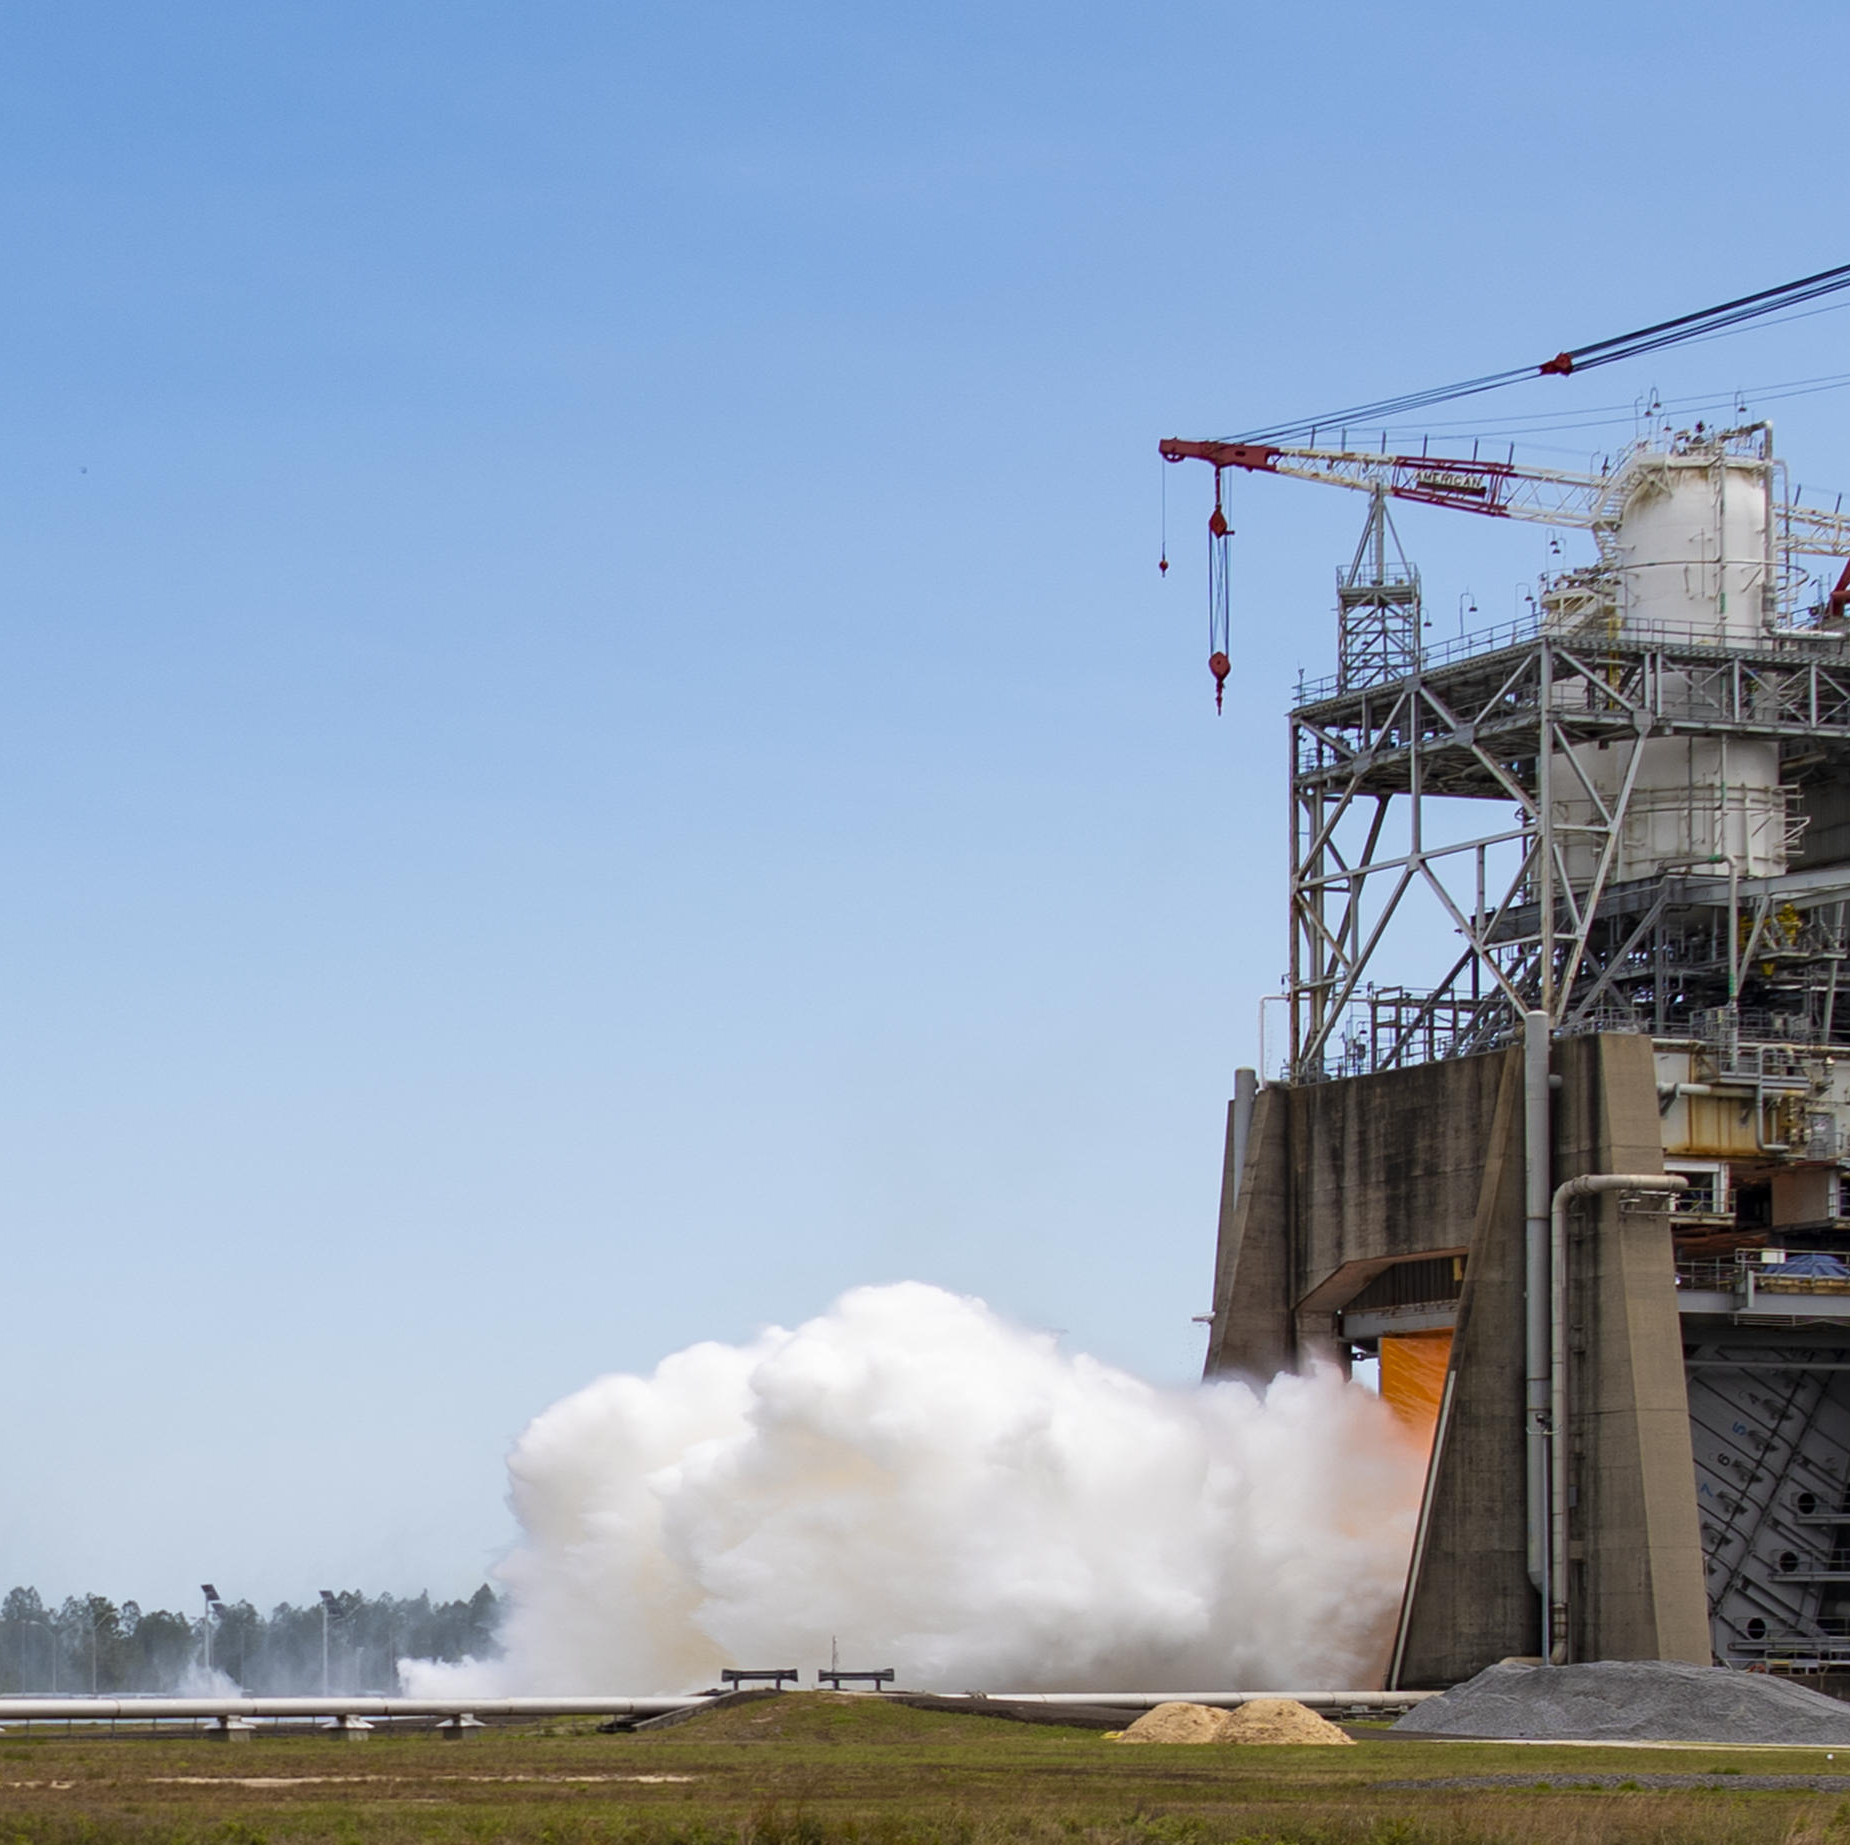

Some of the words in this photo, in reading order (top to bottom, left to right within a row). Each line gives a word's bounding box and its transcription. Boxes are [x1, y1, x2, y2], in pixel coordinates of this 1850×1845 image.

[1412, 468, 1483, 488] AMERICAN
[1732, 1421, 1747, 1436] 5
[1717, 1452, 1731, 1467] 6
[1700, 1482, 1714, 1497] 7
